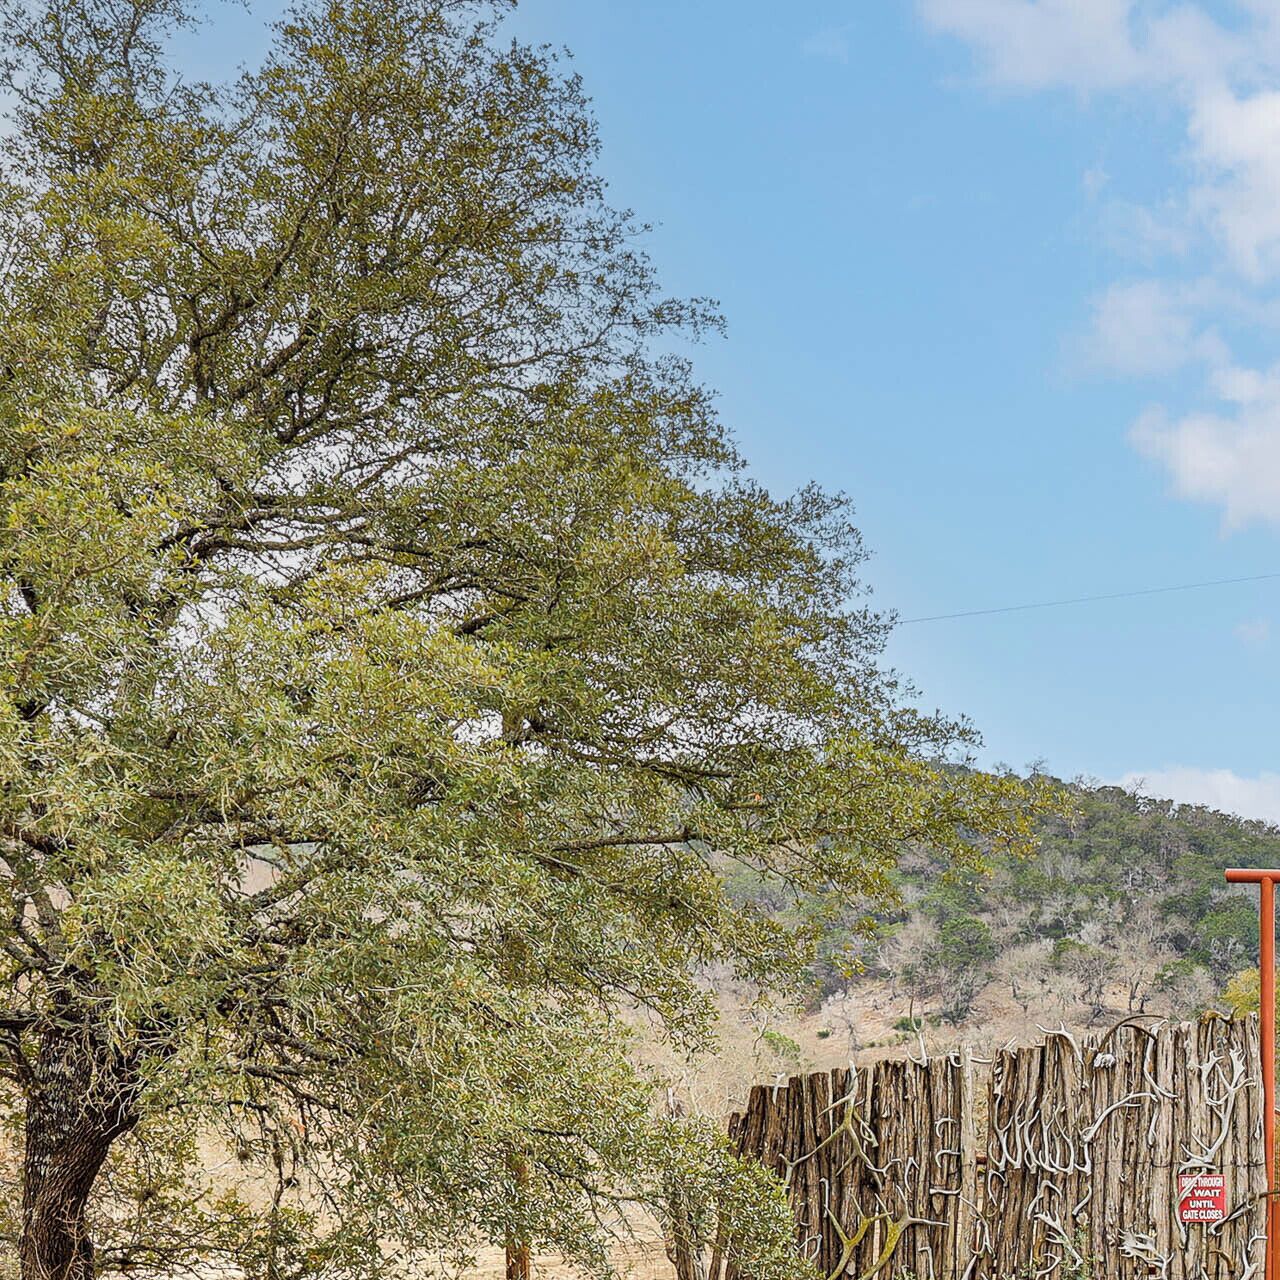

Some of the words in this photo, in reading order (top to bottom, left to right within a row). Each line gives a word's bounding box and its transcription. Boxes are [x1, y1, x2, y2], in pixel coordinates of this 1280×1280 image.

[1198, 1177, 1223, 1187] THROUGH
[1194, 1189, 1221, 1197] WAIT
[1190, 1200, 1216, 1208] UNTIL
[1183, 1210, 1198, 1219] GATE
[1199, 1210, 1223, 1219] CLOSES
